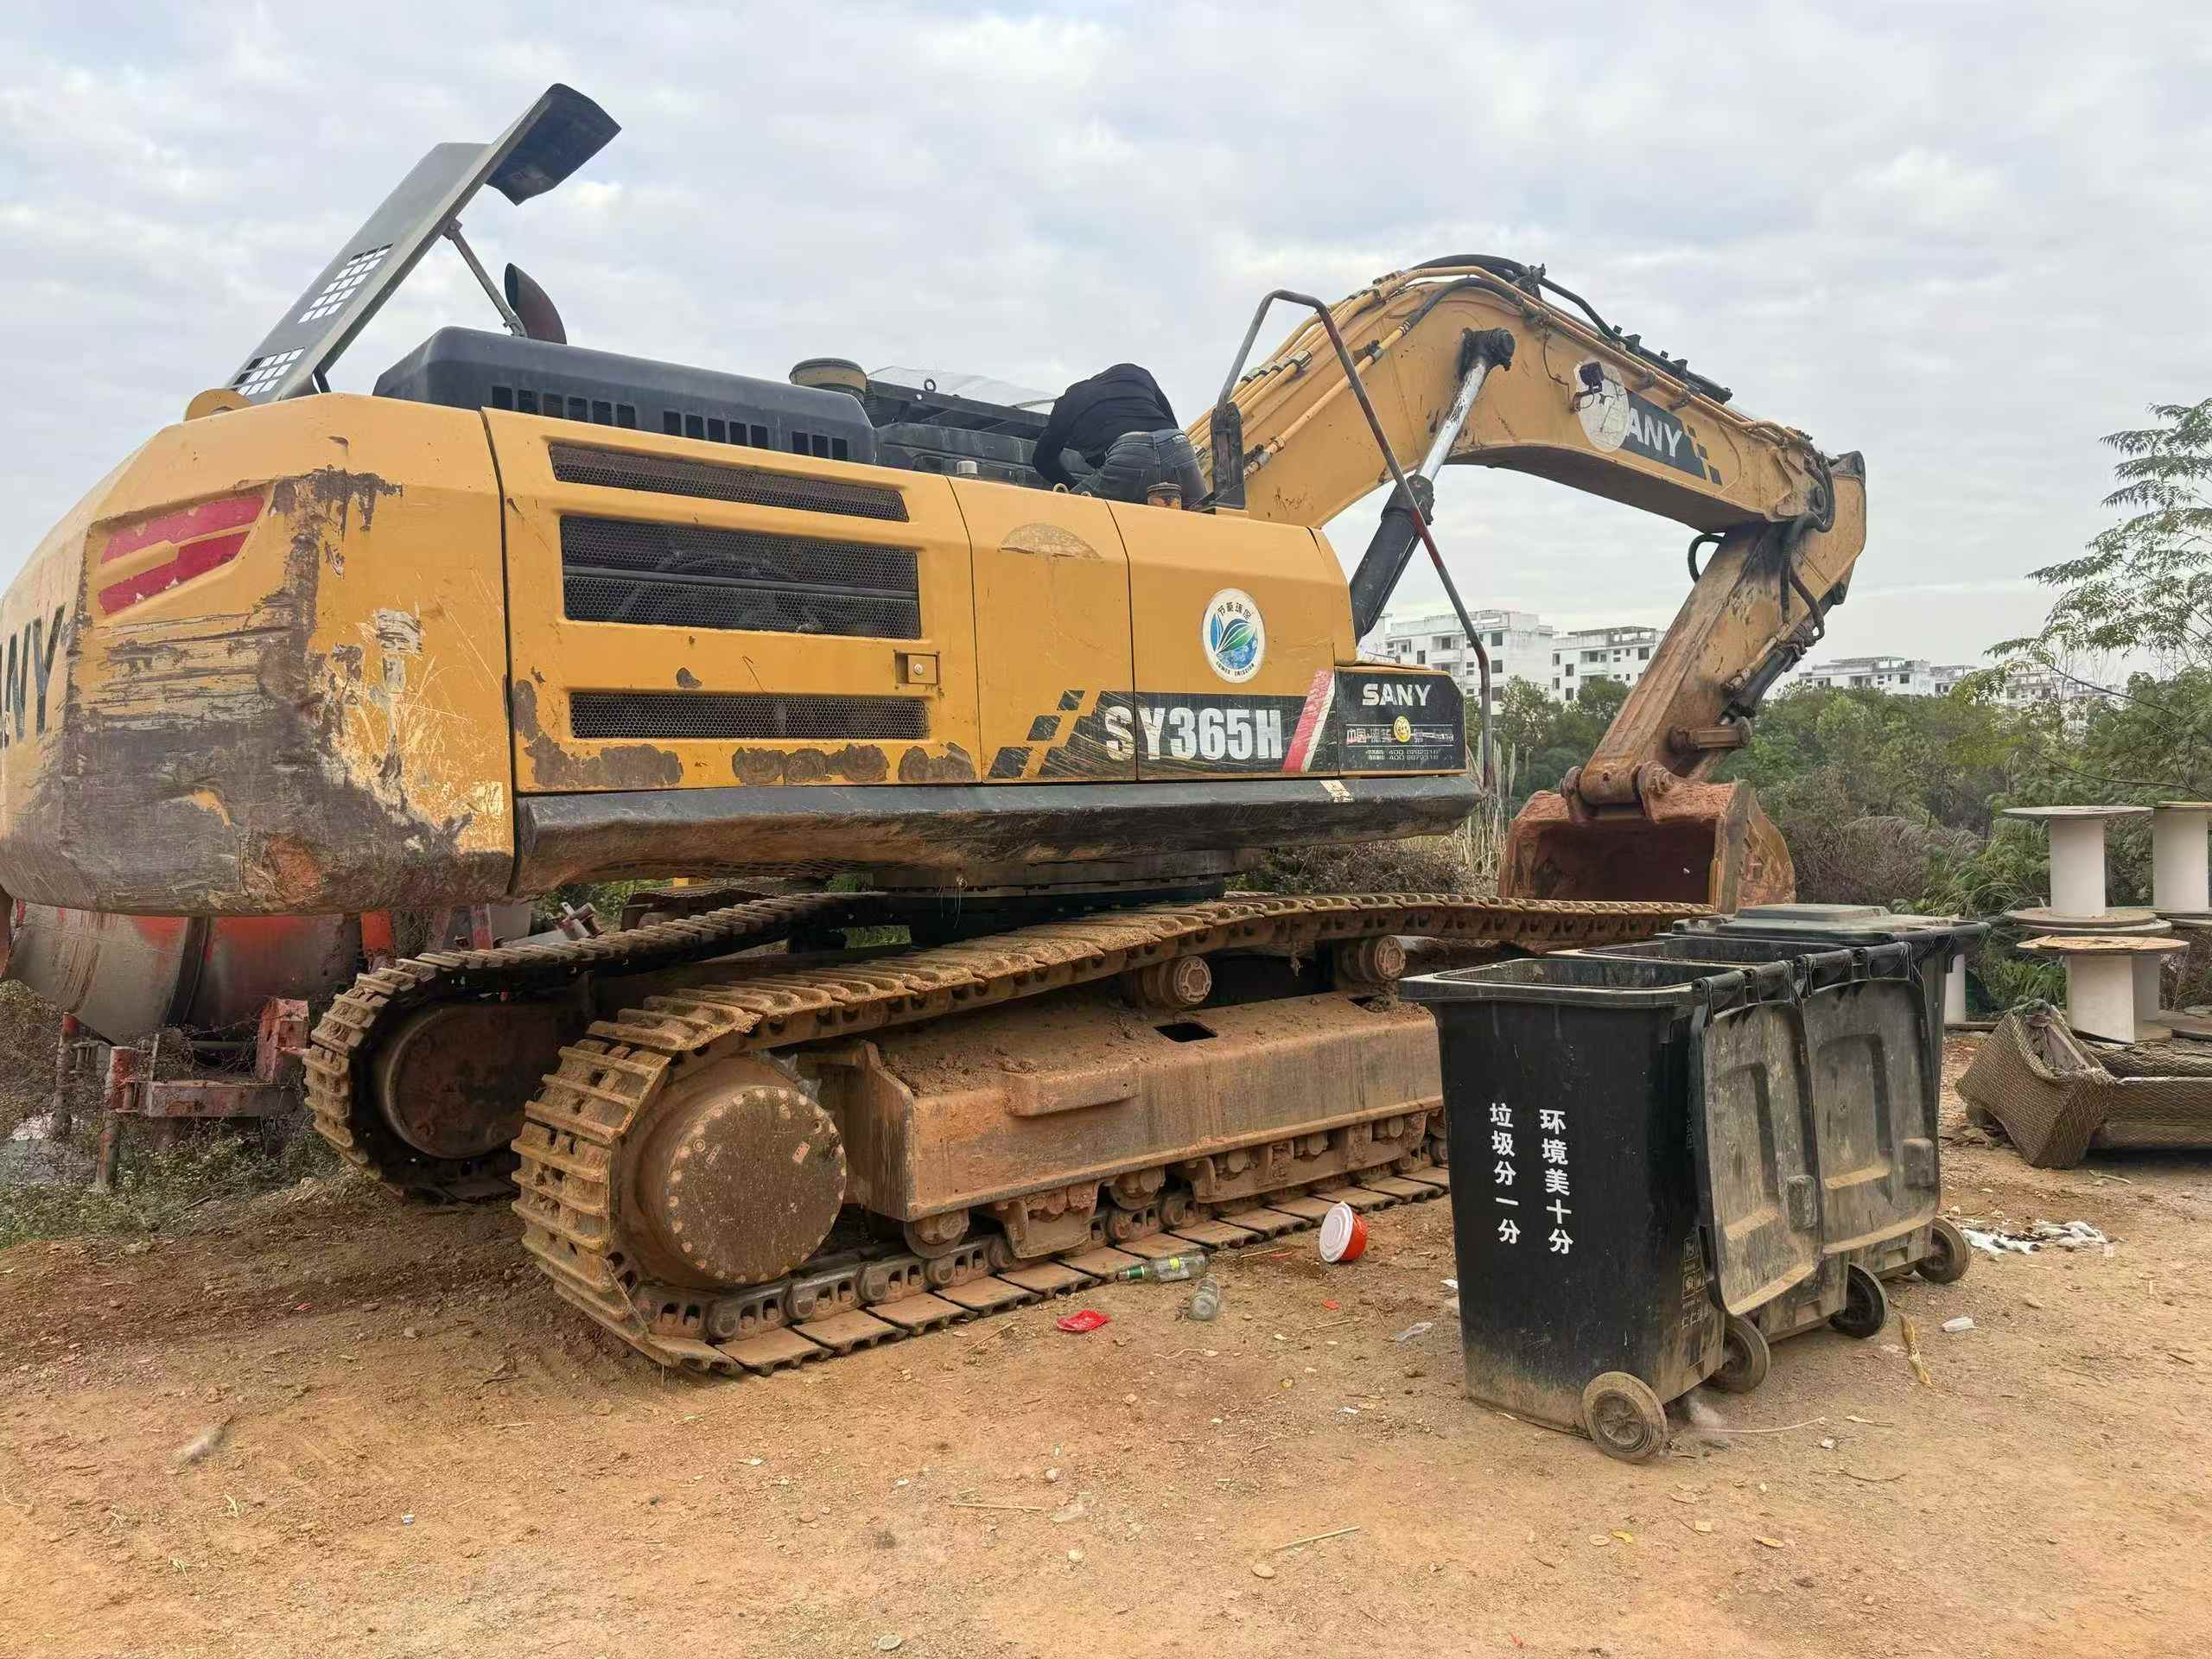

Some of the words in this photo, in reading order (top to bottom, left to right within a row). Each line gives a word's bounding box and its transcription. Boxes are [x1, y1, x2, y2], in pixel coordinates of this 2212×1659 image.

[1629, 407, 1683, 458] ANY
[1362, 683, 1431, 706] SANY
[1104, 705, 1283, 761] SY365H
[1490, 1103, 1521, 1244] 垃圾分一分
[1539, 1109, 1574, 1255] 环境美十分
